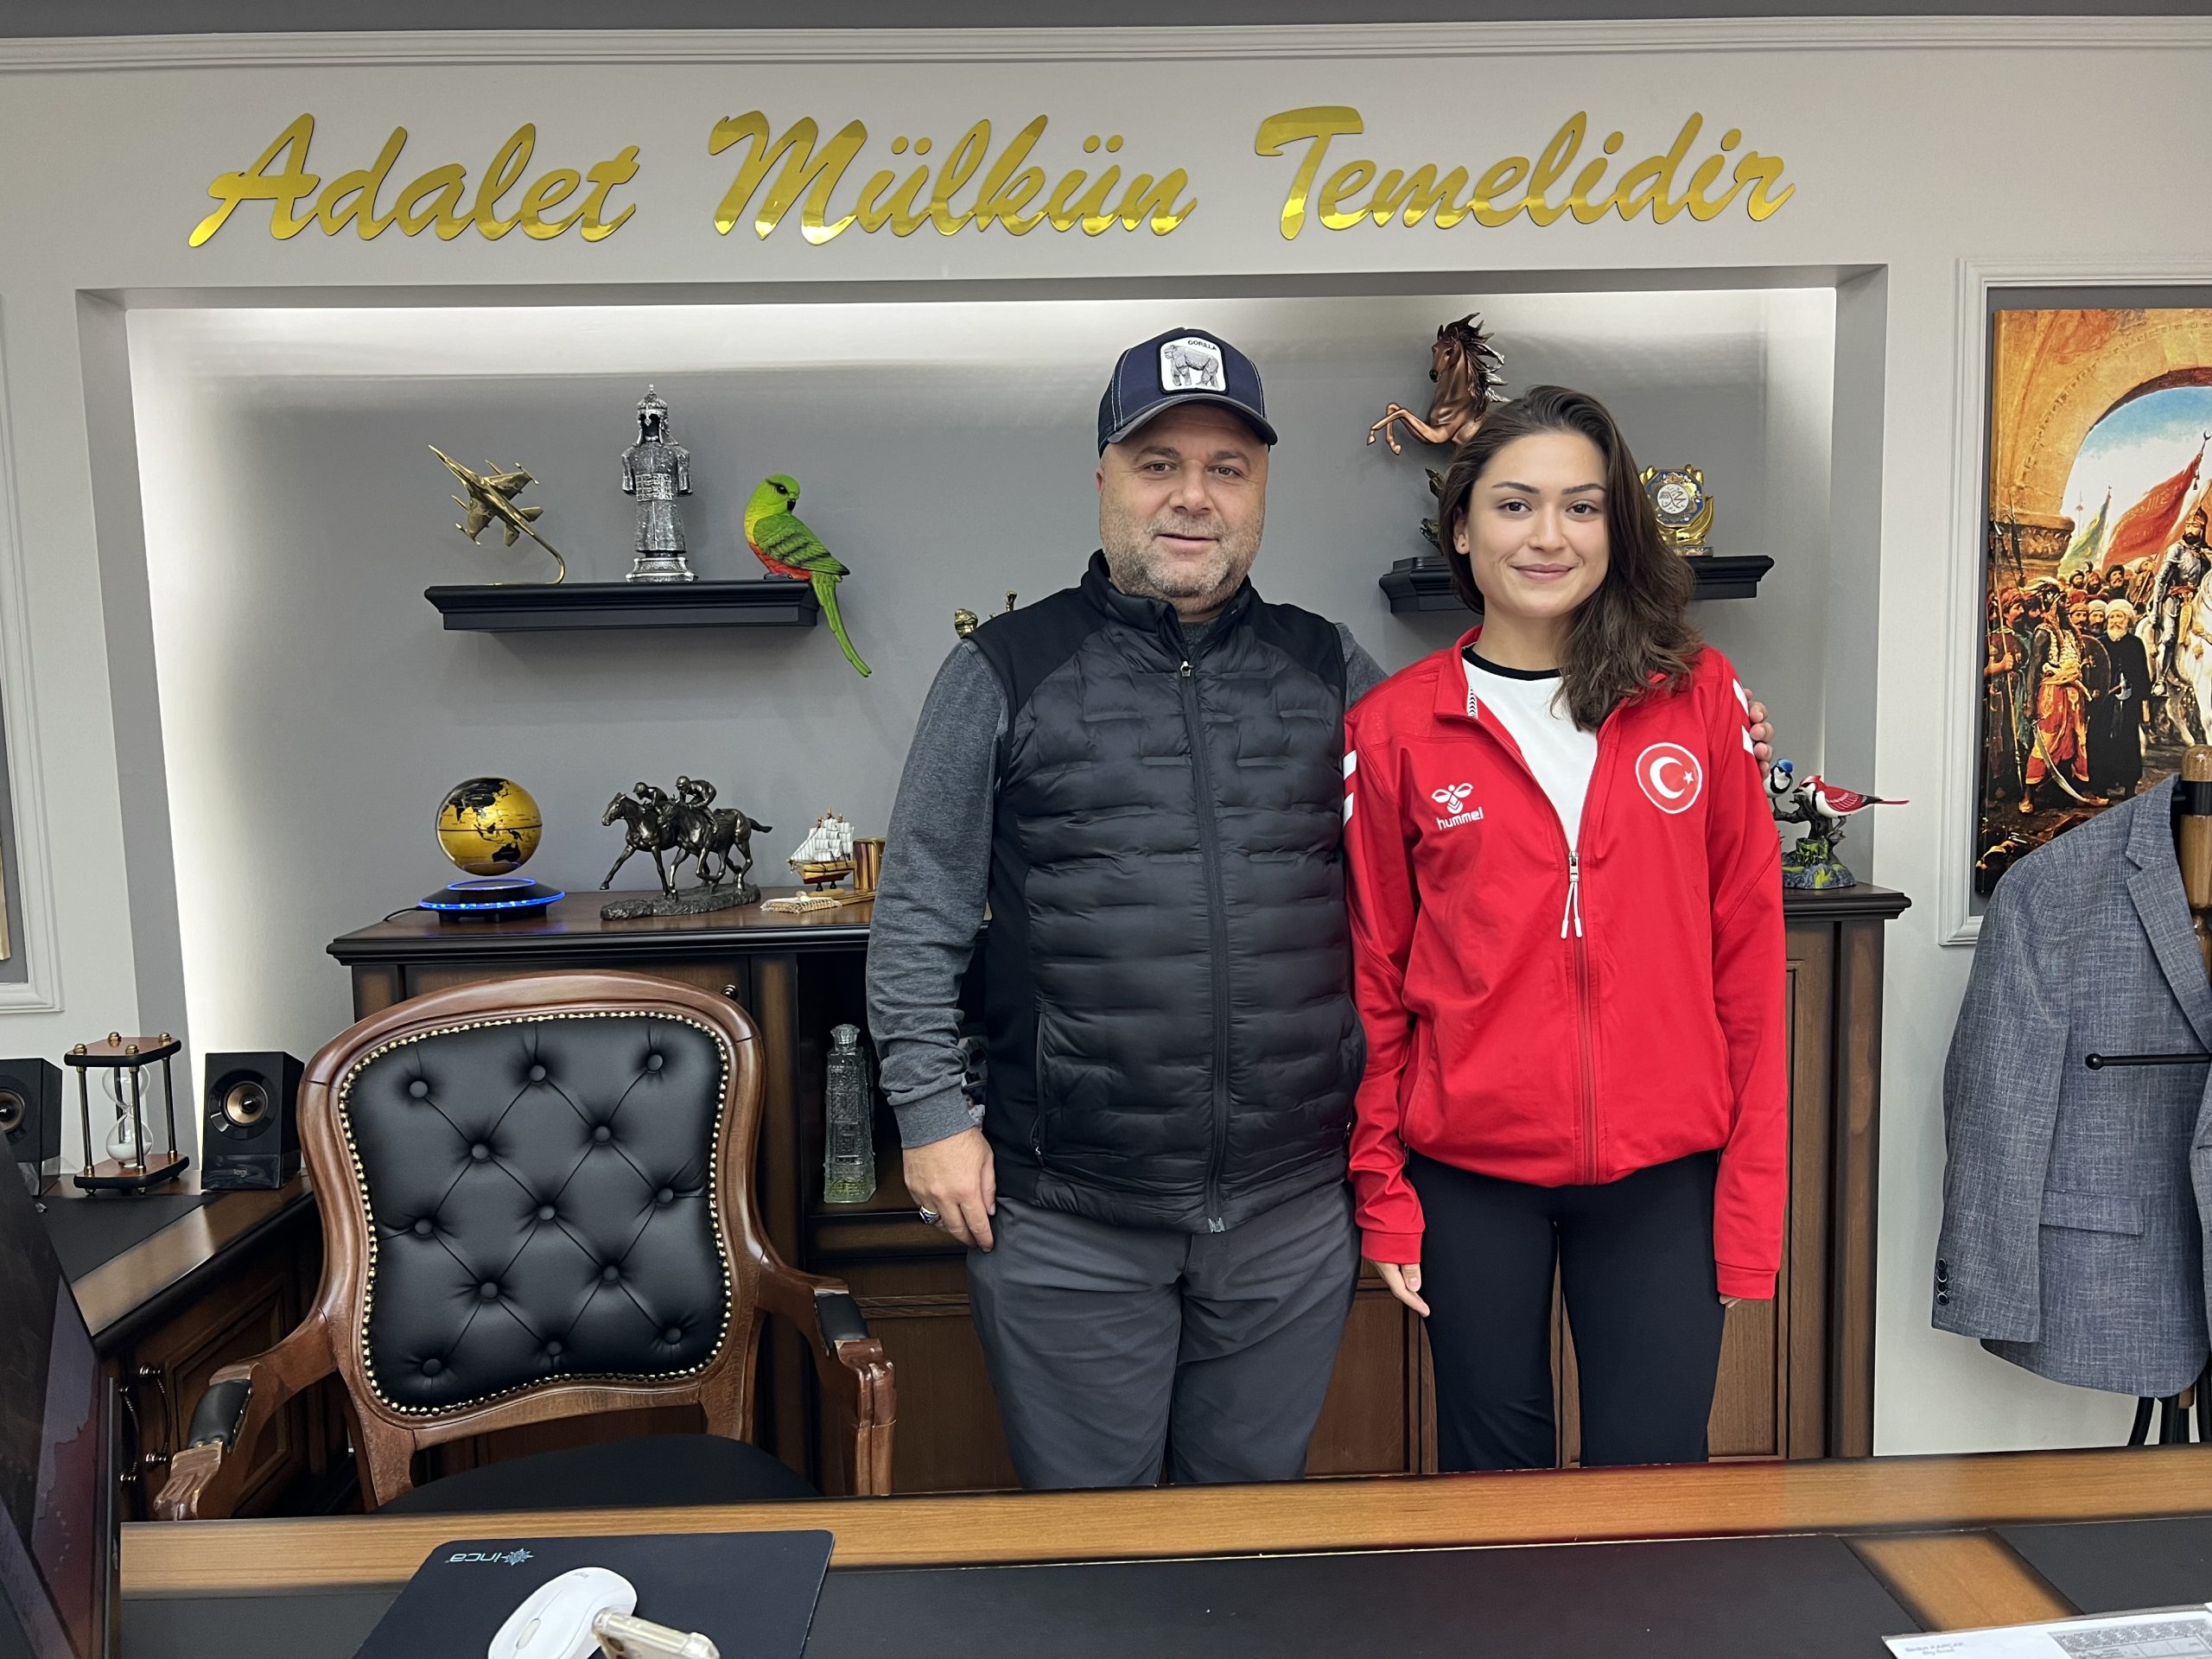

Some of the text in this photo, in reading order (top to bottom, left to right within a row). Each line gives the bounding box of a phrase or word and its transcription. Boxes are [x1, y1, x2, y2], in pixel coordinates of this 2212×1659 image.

[188, 105, 1796, 247] Adalet Mülkün Temelidir
[1187, 340, 1217, 351] GORILLA
[1436, 806, 1484, 830] hummel
[449, 1552, 502, 1563] inca
